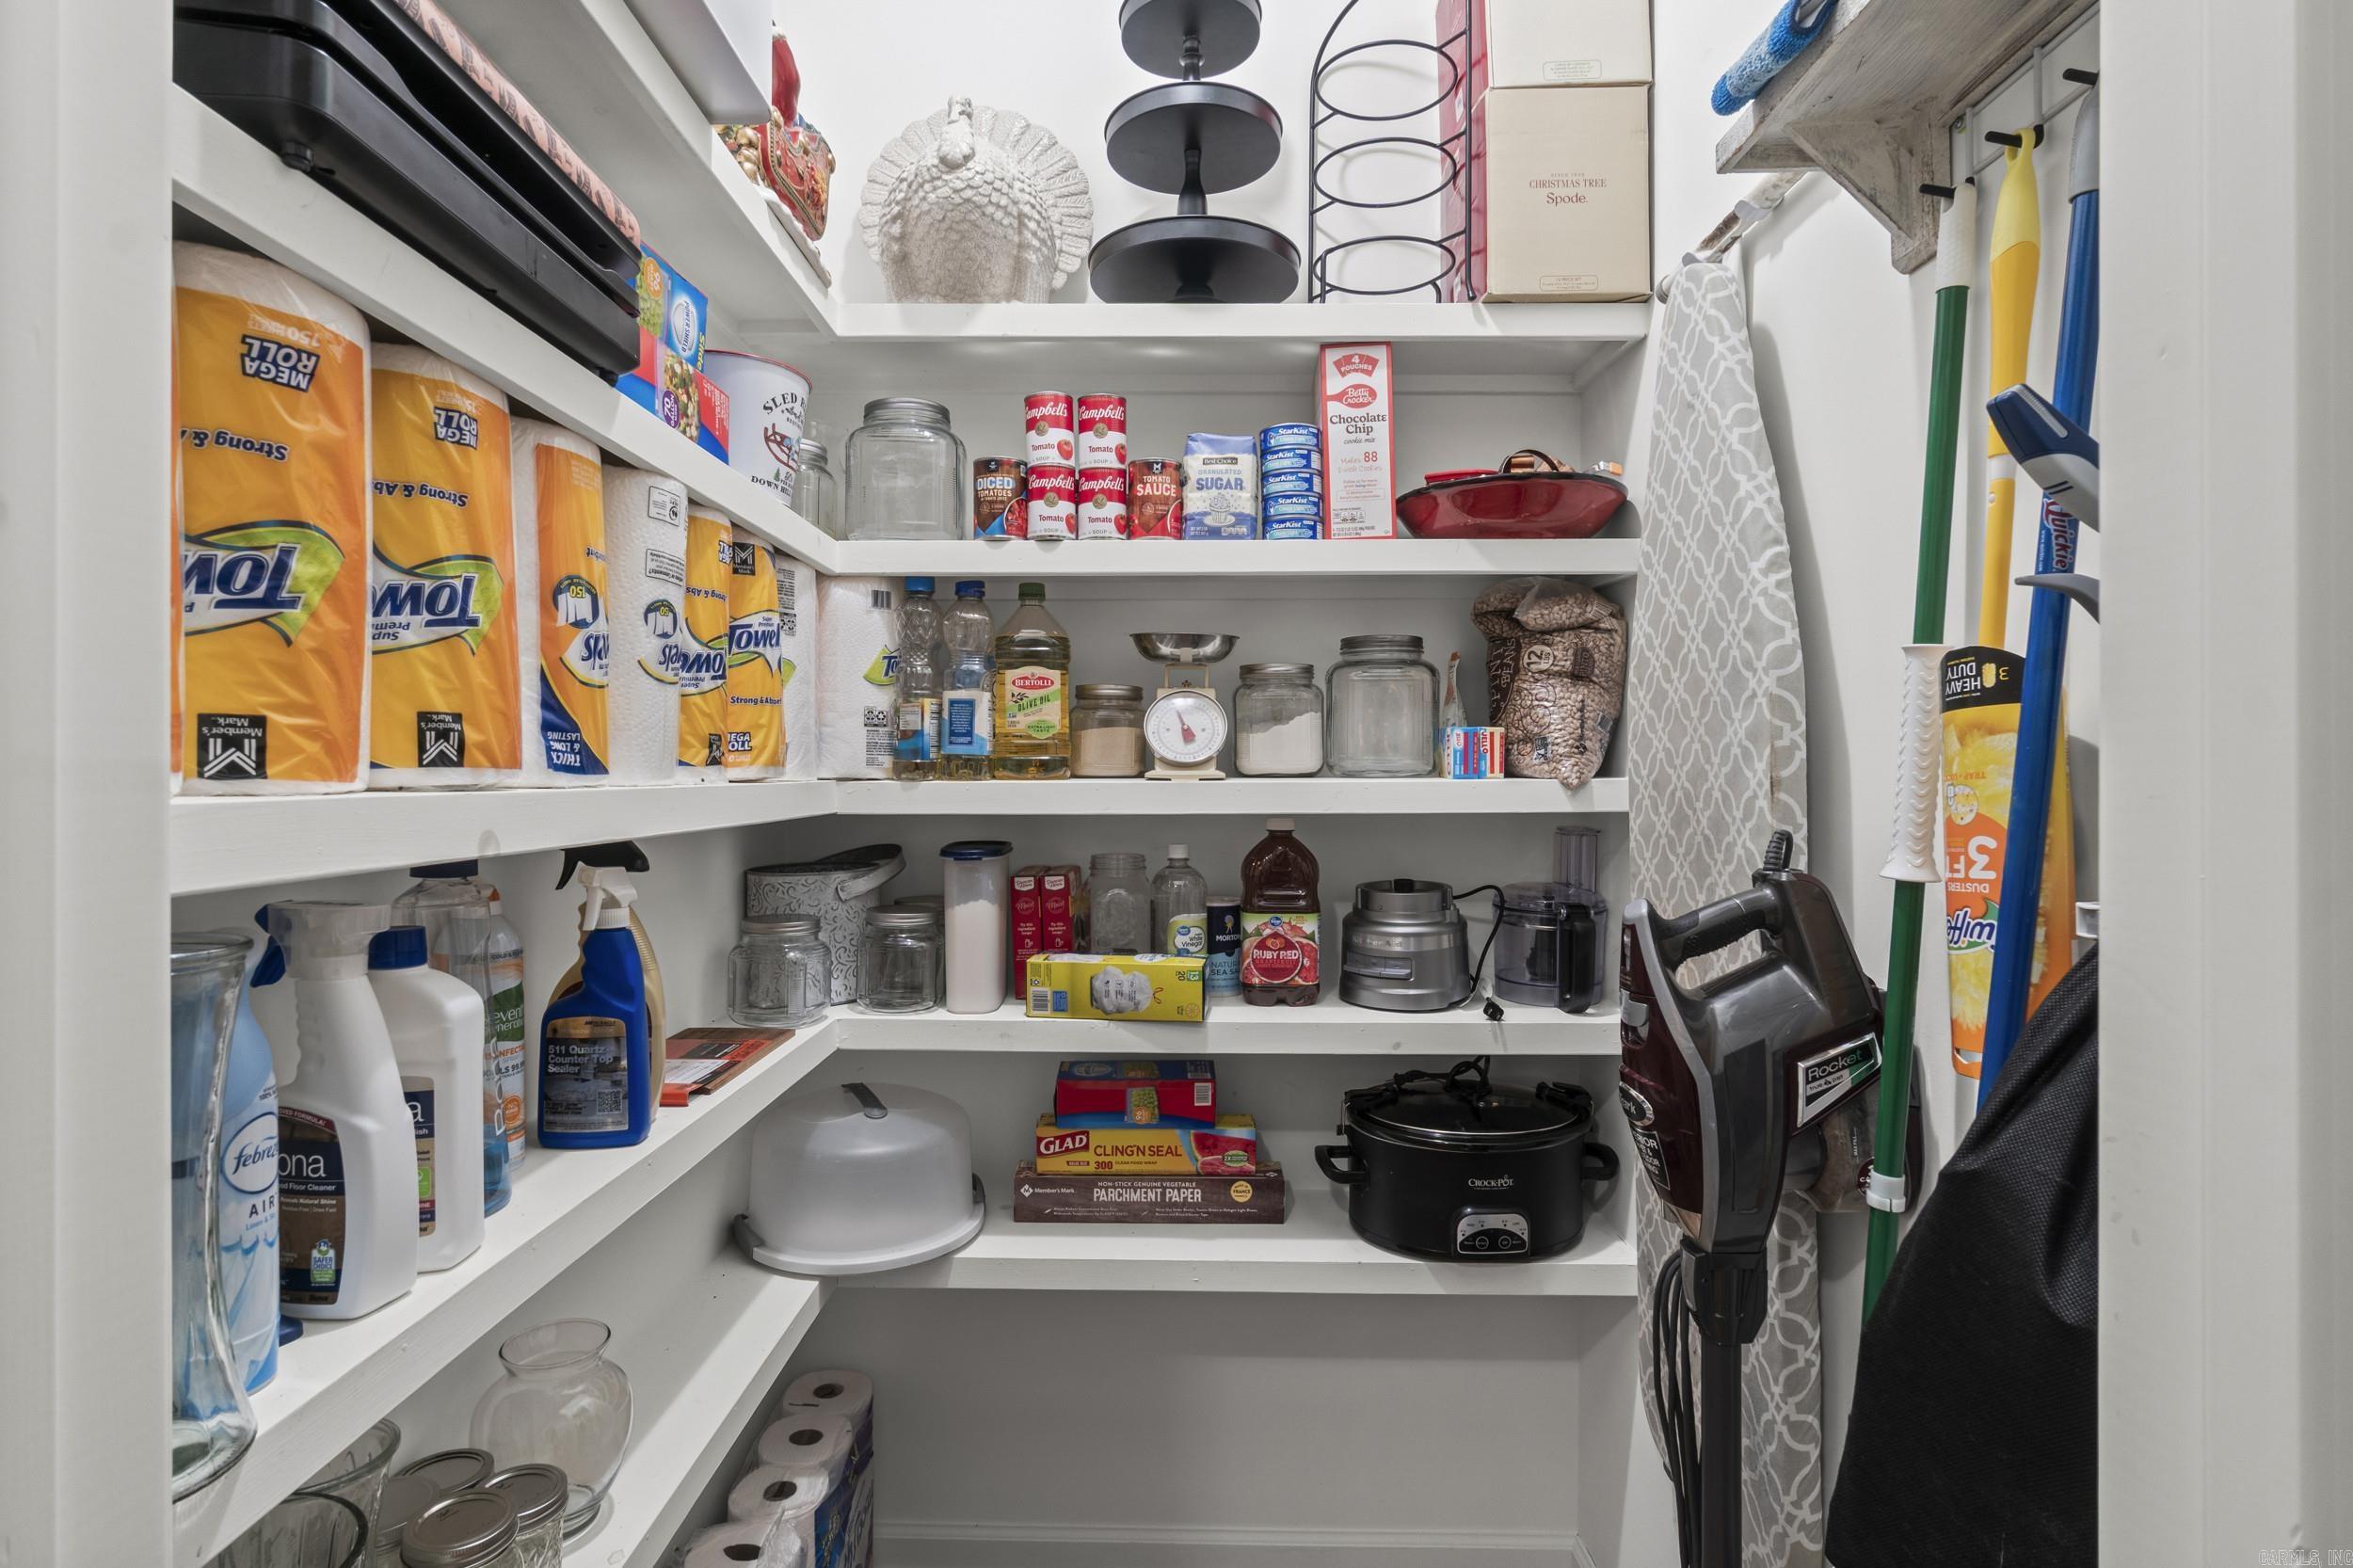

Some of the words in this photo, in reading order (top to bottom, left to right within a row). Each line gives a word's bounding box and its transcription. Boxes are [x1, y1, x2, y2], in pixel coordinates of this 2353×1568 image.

[1529, 179, 1580, 188] CHRISTMAS
[1583, 178, 1608, 187] TREE
[681, 328, 690, 353] SHIELD
[245, 337, 317, 374] ROLL
[1351, 355, 1360, 363] 4
[244, 356, 311, 390] MEGA
[1340, 363, 1372, 372] POUCHES
[1342, 395, 1373, 405] Crocker
[1347, 388, 1369, 399] Betty
[664, 396, 671, 416] 70
[762, 392, 798, 415] SLED
[1078, 403, 1125, 421] Campbell's
[1329, 413, 1387, 424] Chocolate
[436, 408, 477, 435] ROLL
[436, 424, 477, 449] MEGA
[1345, 424, 1373, 436] Chip
[191, 429, 209, 448] &
[1343, 437, 1364, 445] cookie
[215, 430, 288, 461] Strong
[1032, 442, 1055, 452] Tomato
[1088, 445, 1113, 454] Tomato
[1266, 452, 1294, 460] StarKist
[1363, 451, 1378, 463] 88
[751, 475, 779, 490] DOWN
[976, 477, 1014, 489] DICED
[1028, 473, 1075, 490] Campbell's
[1079, 474, 1125, 491] Campbell's
[1195, 477, 1244, 490] SUGAR
[1268, 474, 1297, 483] StarKist
[403, 482, 416, 498] &
[419, 483, 468, 508] Strong
[978, 489, 1012, 498] TOMATOES
[1136, 484, 1176, 497] SAUCE
[1038, 514, 1064, 522] Tomato
[1272, 520, 1302, 529] StarKist
[569, 584, 586, 600] 150
[712, 589, 728, 602] trong
[372, 572, 483, 629] Tow
[1501, 638, 1516, 688] BEANS
[1526, 649, 1545, 668] 12
[1543, 651, 1551, 664] LBS
[1946, 662, 1977, 680] DUTY
[1998, 666, 2009, 680] 3
[1945, 677, 1981, 696] HEAVY
[730, 696, 759, 706] Strong
[1017, 697, 1038, 712] OLIVE
[1040, 695, 1051, 705] OIL
[201, 725, 263, 738] Member's
[420, 721, 462, 731] Member's
[547, 730, 581, 741] LASTING
[550, 740, 573, 751] LONG
[728, 741, 752, 751] OLL
[552, 751, 582, 767] THICK
[1963, 771, 1987, 780] TRAP
[1968, 835, 1997, 880] 3
[1945, 855, 1966, 879] FT
[1947, 881, 1990, 893] DUSTERS
[1254, 949, 1278, 959] RUBY
[1279, 950, 1300, 959] RED
[1177, 970, 1186, 982] 20
[1189, 971, 1199, 980] 13
[548, 1045, 566, 1054] 511
[568, 1045, 605, 1054] Quartz
[548, 1055, 588, 1064] Counter
[593, 1055, 614, 1064] Top
[1808, 1049, 1865, 1081] Rocket
[548, 1064, 581, 1074] Sealer
[294, 1109, 326, 1126] FORMULA!
[1039, 1135, 1087, 1155] GLAD
[1147, 1144, 1181, 1157] SEAL
[232, 1141, 279, 1176] febrez
[1094, 1160, 1113, 1170] 300
[289, 1183, 306, 1192] Floor
[307, 1183, 336, 1192] Cleaner
[1093, 1189, 1163, 1202] PARCHMENT
[1165, 1189, 1202, 1203] PAPER
